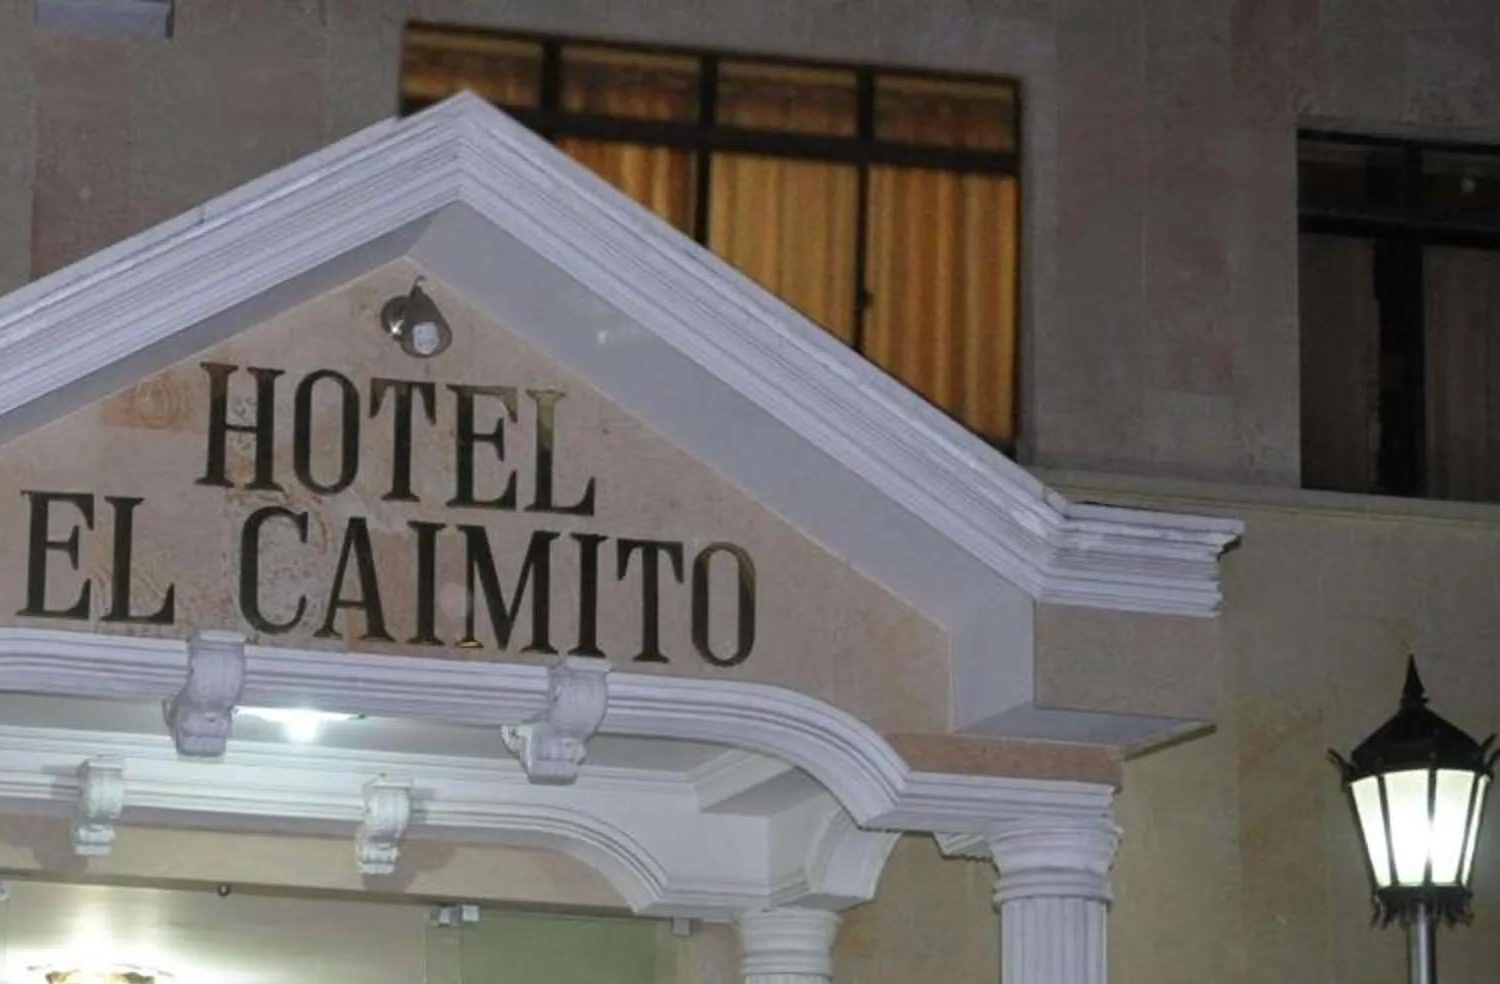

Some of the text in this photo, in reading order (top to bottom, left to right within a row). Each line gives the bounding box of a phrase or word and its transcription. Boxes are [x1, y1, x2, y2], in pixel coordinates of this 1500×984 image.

[194, 360, 596, 517] HOTEL
[15, 489, 758, 668] EL CAIMITO
